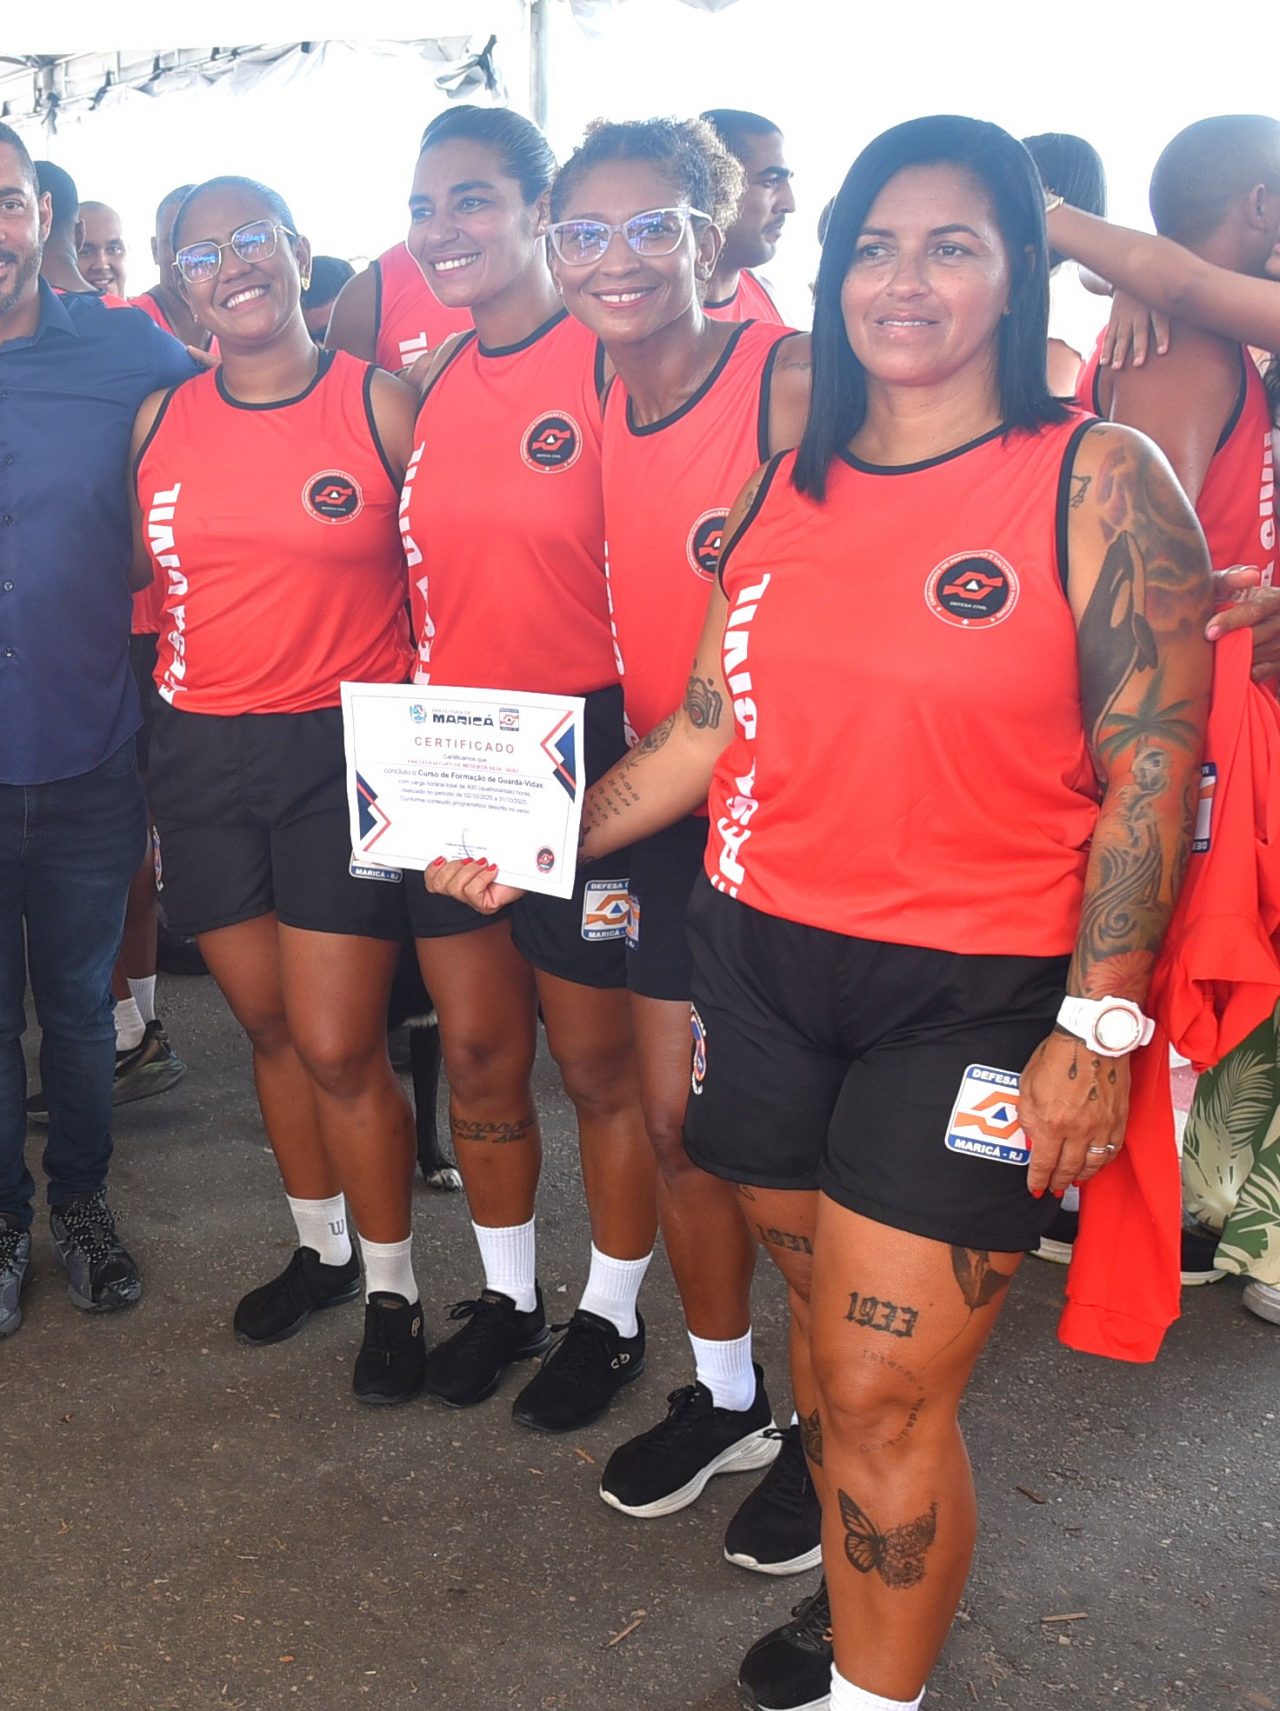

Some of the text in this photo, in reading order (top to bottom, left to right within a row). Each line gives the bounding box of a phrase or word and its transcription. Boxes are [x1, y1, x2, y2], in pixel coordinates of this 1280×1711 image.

[723, 573, 771, 740] CIVIL
[433, 713, 494, 727] MARICÁ
[414, 736, 514, 754] CERTIFICADO
[418, 769, 439, 778] Curso
[440, 771, 449, 779] de
[451, 772, 486, 782] Formação
[487, 775, 496, 783] de
[497, 777, 544, 789] Guarda-Vidas
[971, 1068, 1018, 1087] DEFESA
[954, 1138, 1000, 1157] MARICÁ
[1009, 1150, 1023, 1161] RJ
